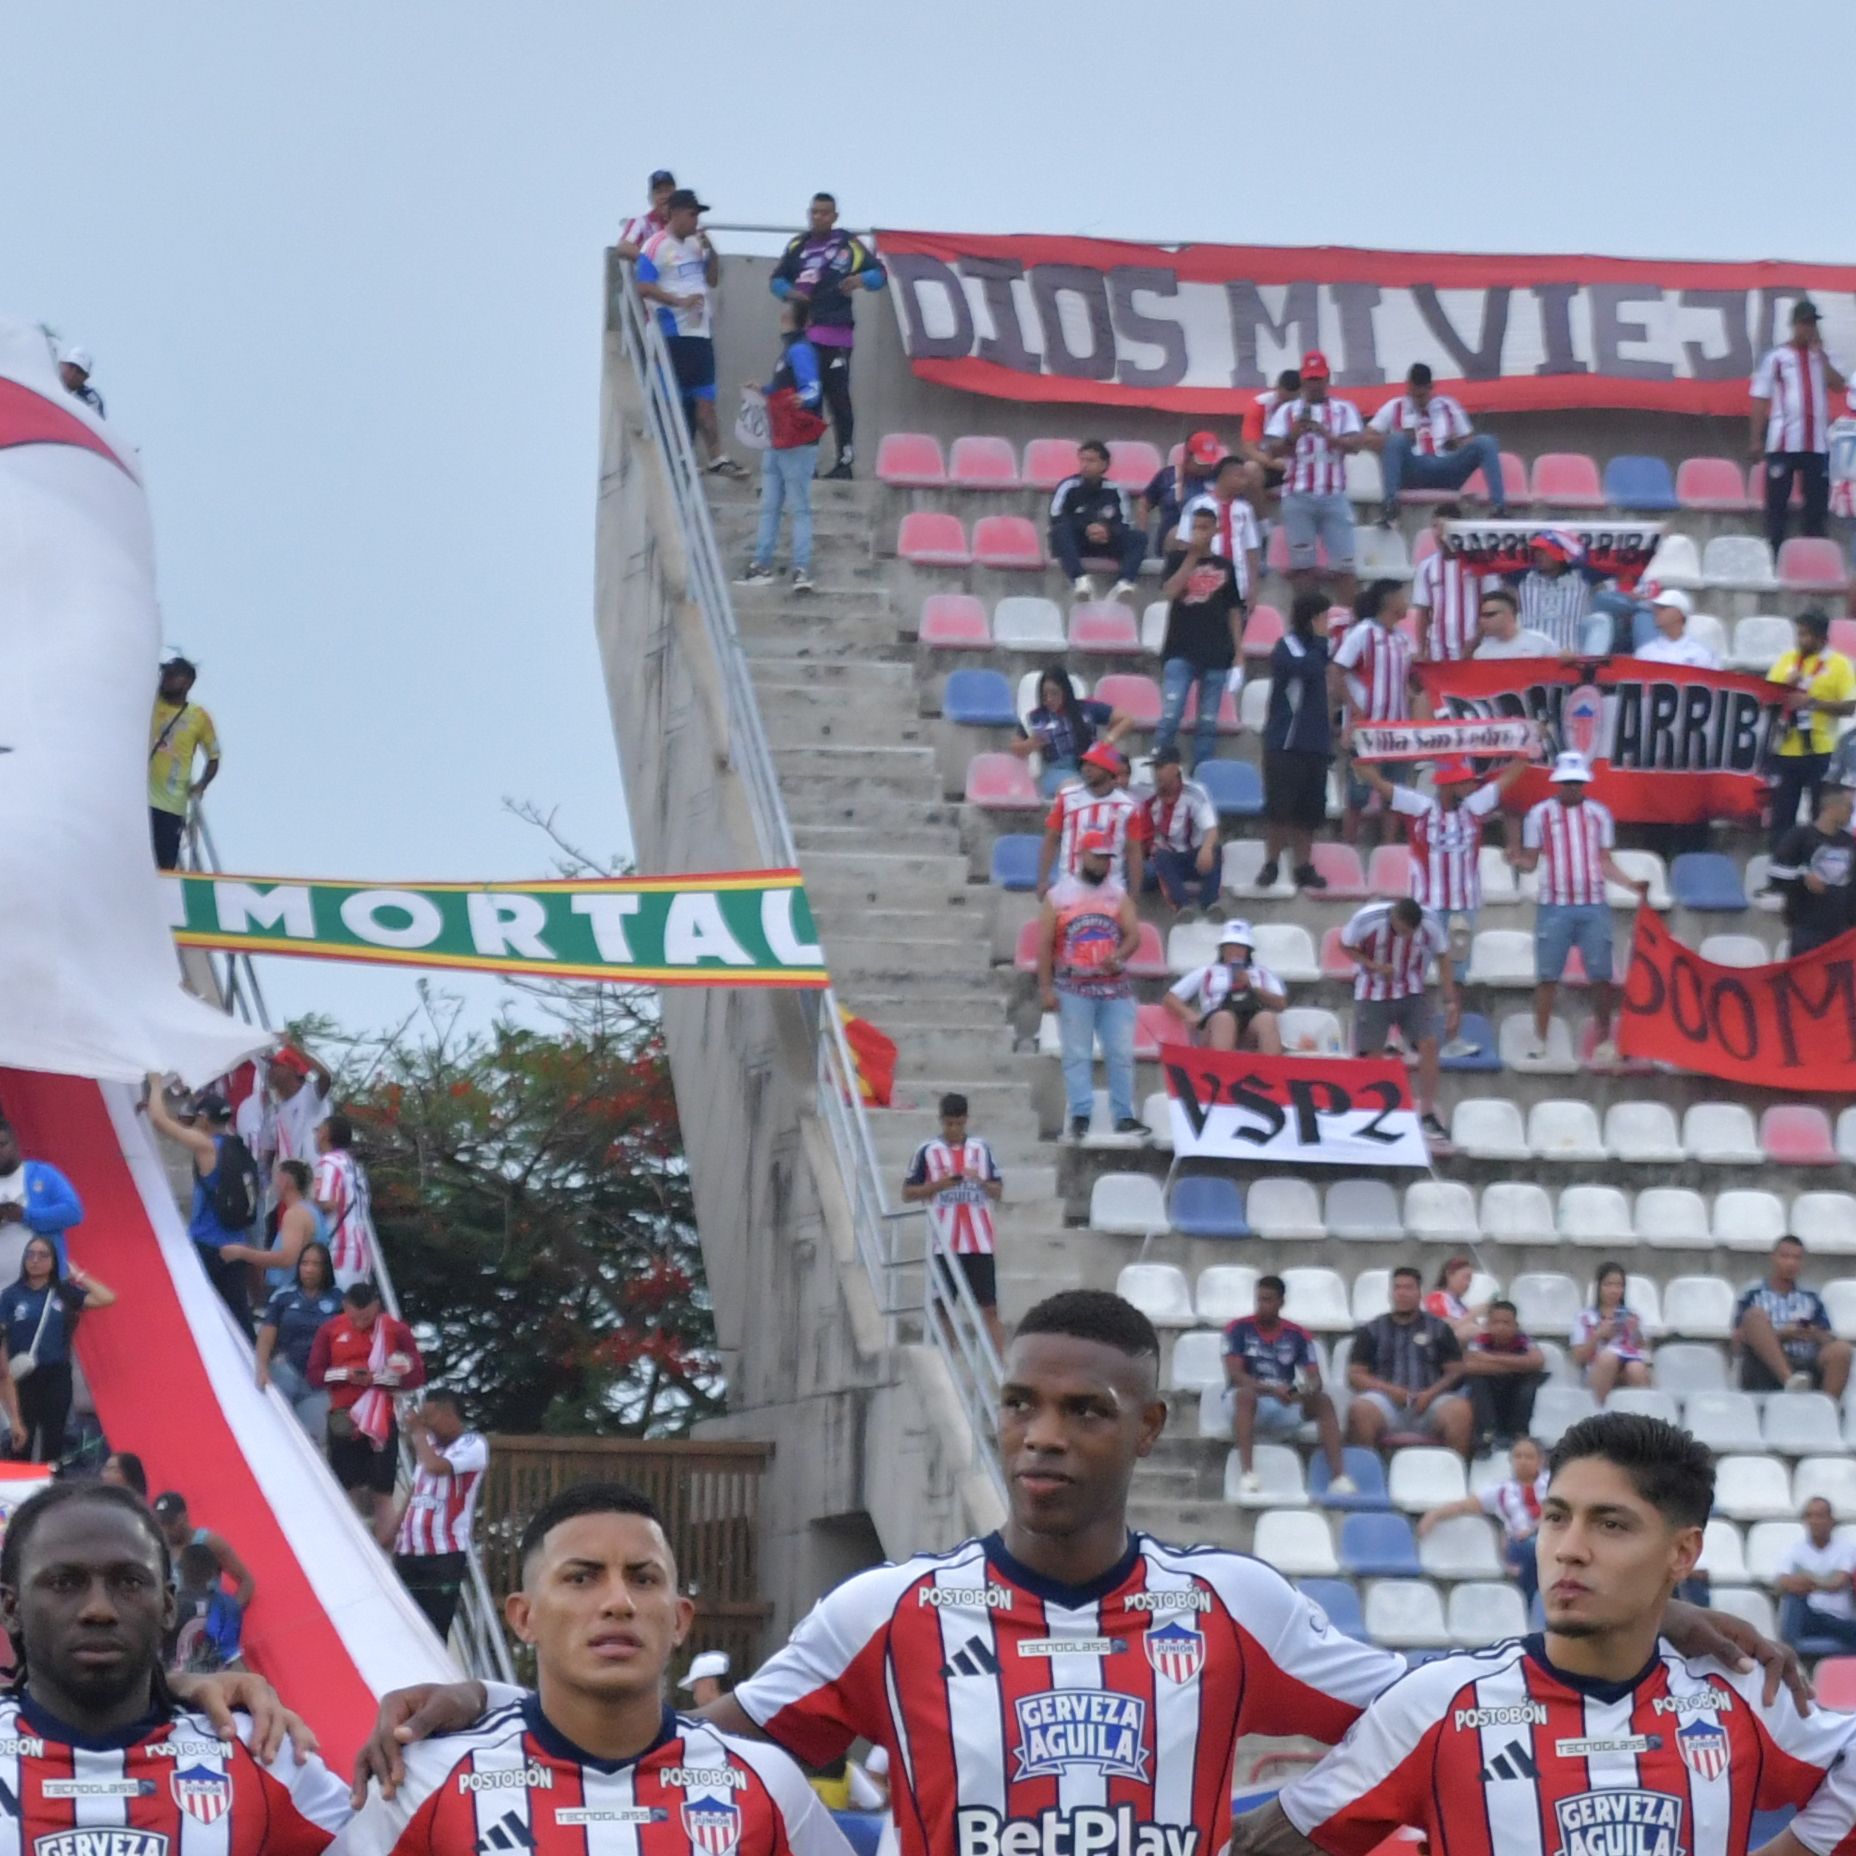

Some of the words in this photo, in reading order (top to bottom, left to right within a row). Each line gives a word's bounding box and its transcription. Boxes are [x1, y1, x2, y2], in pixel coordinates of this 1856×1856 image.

[887, 253, 1188, 388] DIOS
[1229, 280, 1387, 388] MI
[1167, 1064, 1407, 1146] VSP2
[1029, 1724, 1134, 1763] AGUILA
